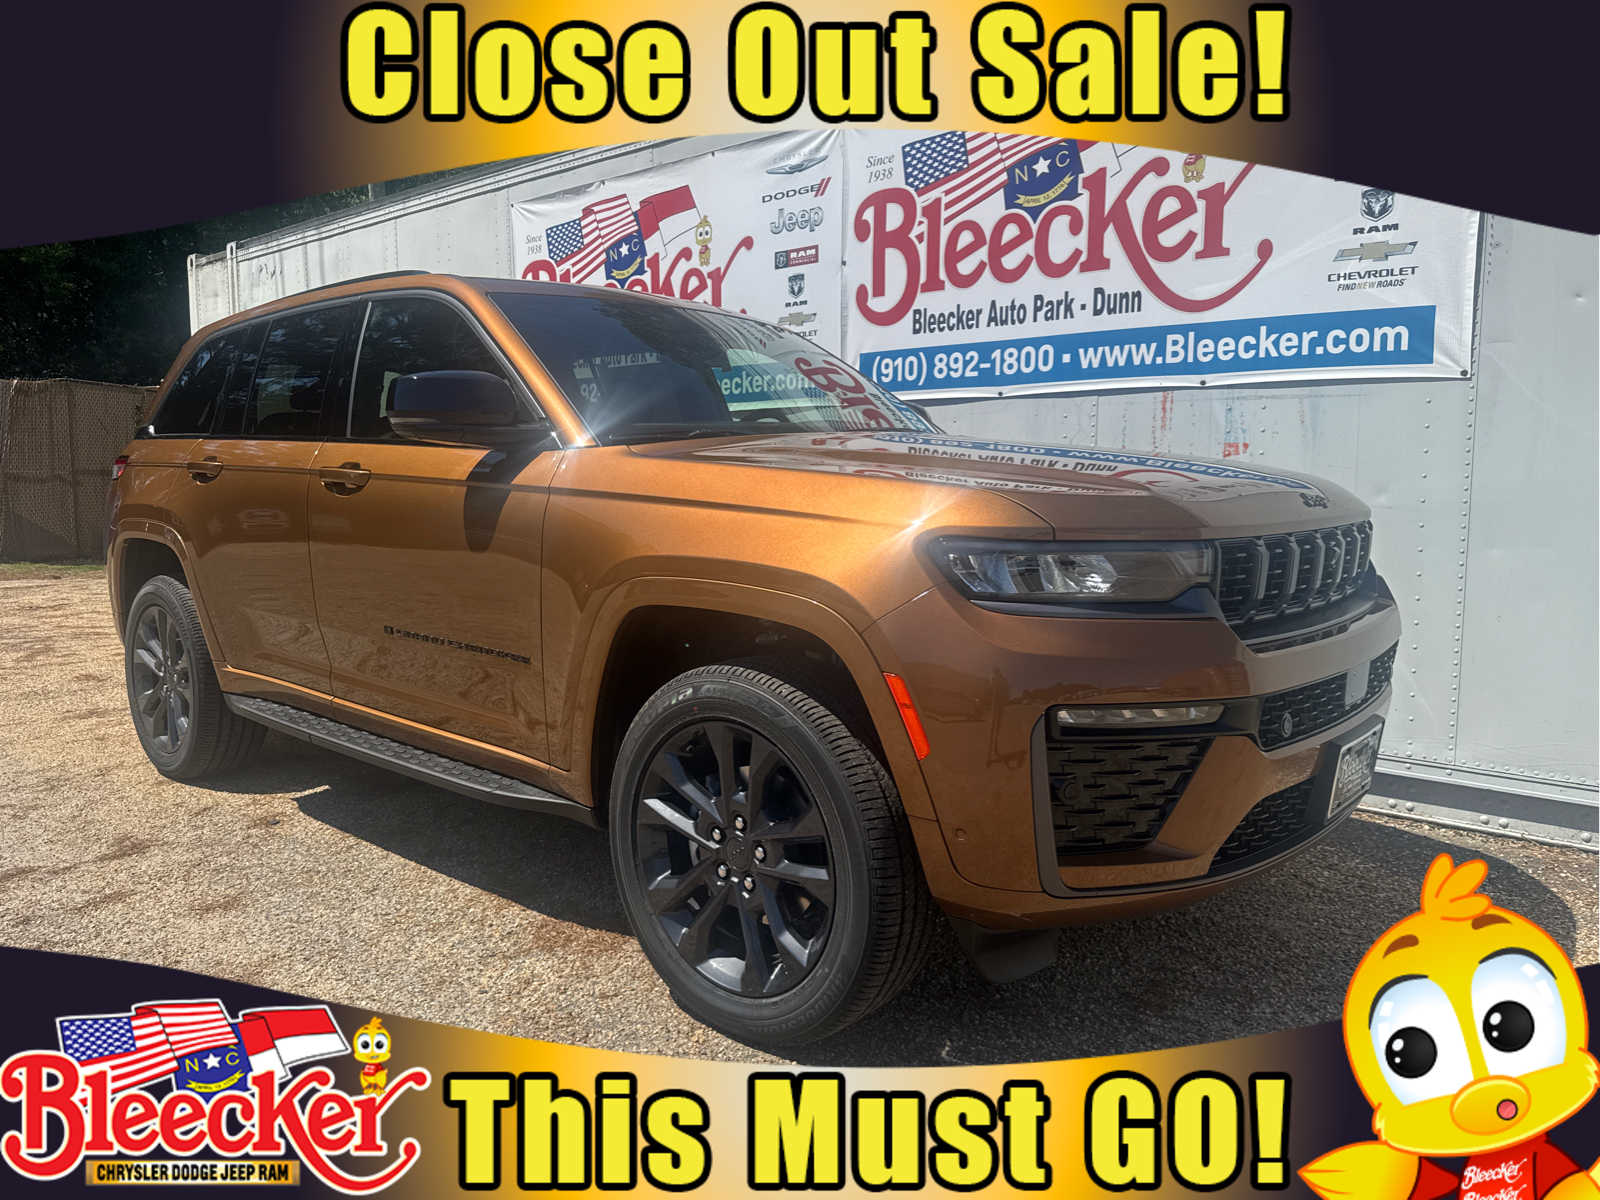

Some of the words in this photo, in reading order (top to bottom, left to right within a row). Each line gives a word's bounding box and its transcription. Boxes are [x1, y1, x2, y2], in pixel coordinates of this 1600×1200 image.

[866, 153, 896, 168] Since
[867, 168, 894, 183] 1938
[762, 184, 821, 204] DODGE
[769, 206, 825, 235] Jeep
[1352, 222, 1400, 235] RAM
[790, 248, 817, 259] RAM
[1328, 266, 1420, 283] CHEVROLET
[784, 300, 808, 308] RAM
[912, 305, 981, 335] Bleecker
[989, 299, 1027, 330] Auto
[1033, 291, 1075, 324] Park
[1092, 287, 1143, 318] Dunn
[872, 351, 928, 387] (910)
[933, 343, 1056, 379] 892-1800
[1079, 323, 1410, 369] www.Bleecker.com
